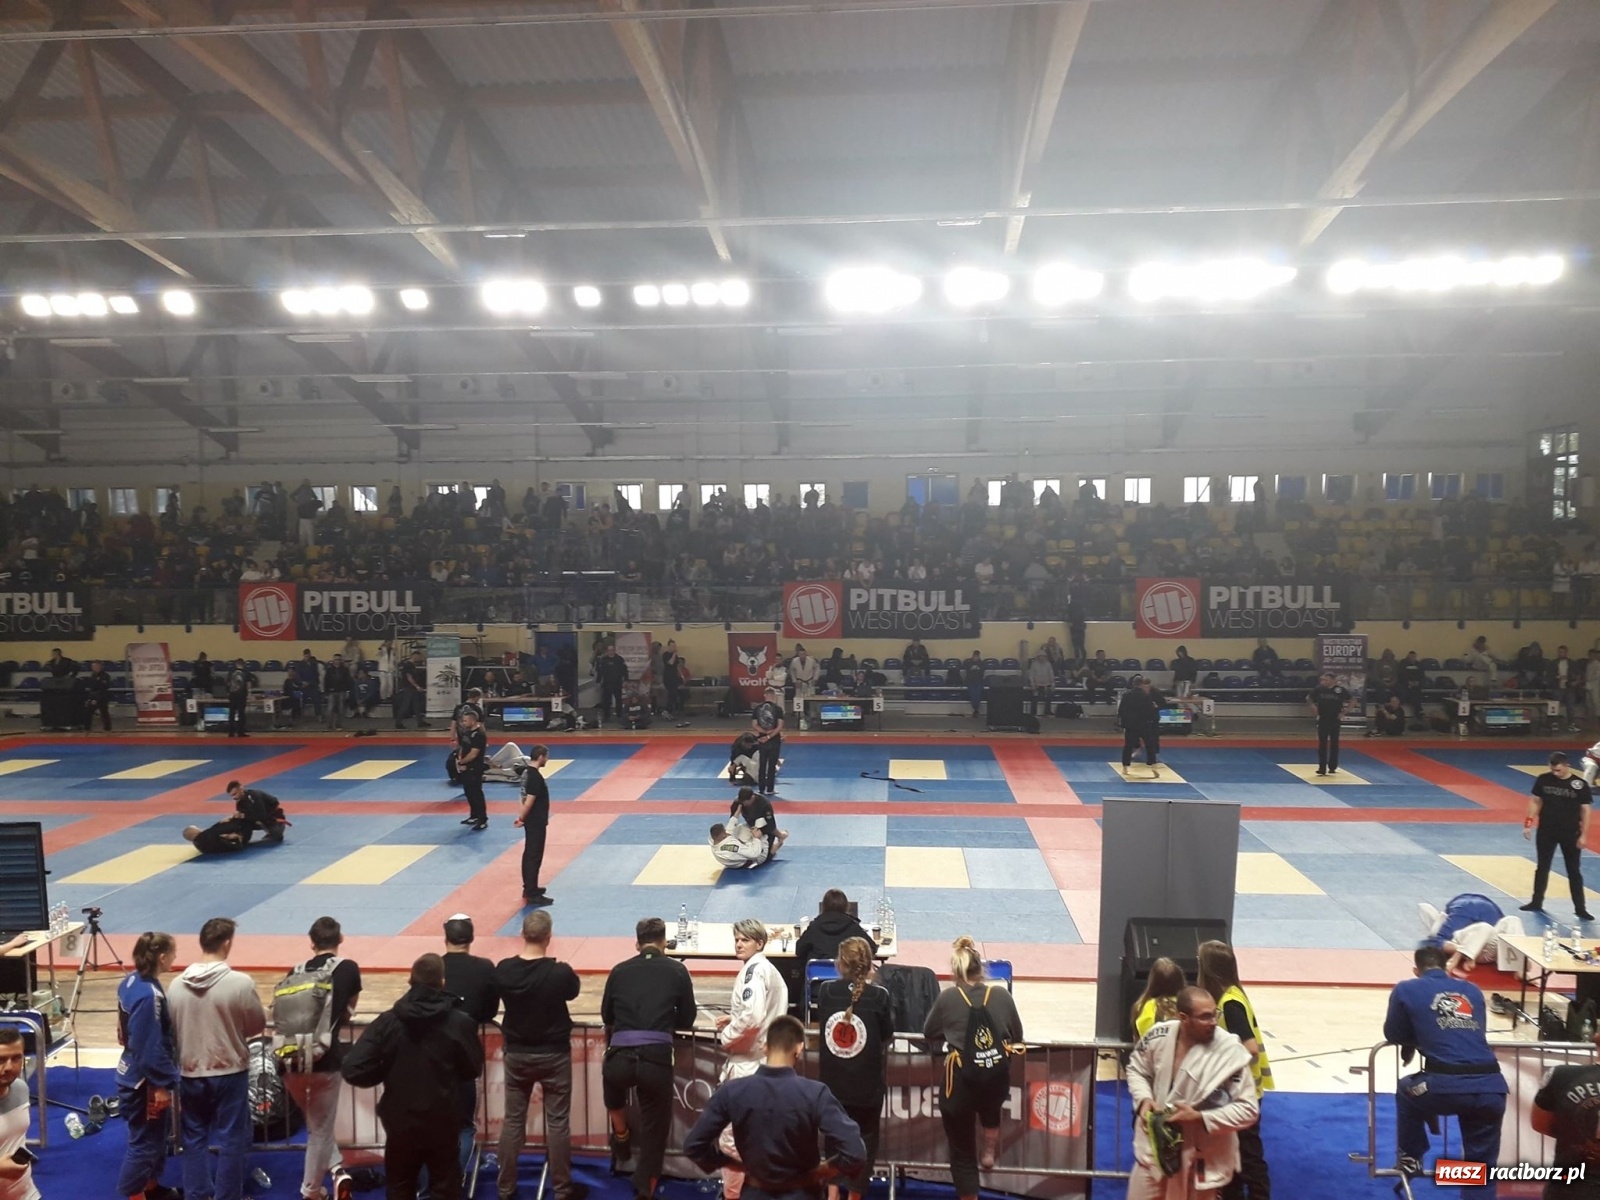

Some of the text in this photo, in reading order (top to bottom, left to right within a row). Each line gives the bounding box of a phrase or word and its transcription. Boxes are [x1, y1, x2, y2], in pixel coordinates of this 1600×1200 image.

[303, 590, 421, 613] PITBULL
[849, 588, 971, 612] PITBULL
[1209, 585, 1340, 610] PITBULL
[1322, 645, 1363, 657] EUROPY
[738, 677, 768, 687] wolf
[66, 934, 76, 951] 8
[1566, 1082, 1600, 1104] OPE
